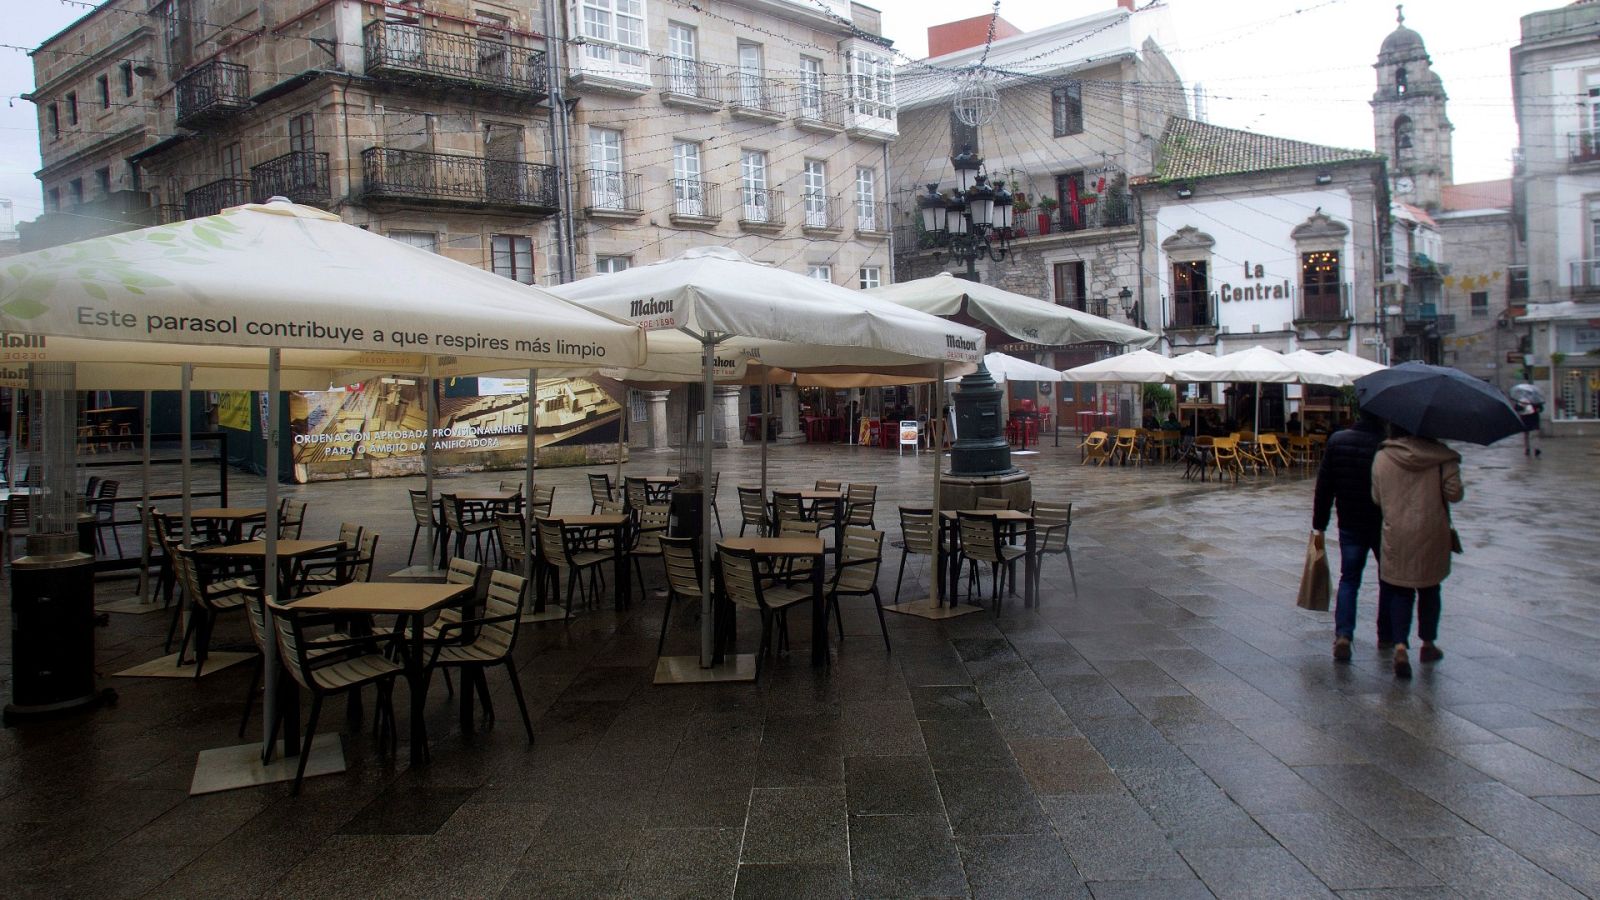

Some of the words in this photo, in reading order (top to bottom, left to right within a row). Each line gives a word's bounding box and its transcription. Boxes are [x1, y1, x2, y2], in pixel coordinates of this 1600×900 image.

[1244, 260, 1264, 279] La
[1221, 280, 1289, 303] Central
[630, 297, 674, 317] Mahou
[78, 306, 137, 328] Este
[147, 315, 237, 333] parasol
[246, 320, 364, 343] contribuye
[373, 329, 384, 342] a
[391, 330, 429, 347] que
[436, 332, 509, 351] respires
[515, 337, 550, 353] más
[557, 339, 606, 360] limpio
[946, 334, 977, 351] Mahou
[374, 429, 428, 440] APROBADA
[432, 424, 522, 438] PROVISIONALMENTE
[325, 446, 354, 456] PARA
[357, 445, 366, 454] O
[370, 440, 408, 453] ÁMBITO
[411, 442, 426, 451] DA
[432, 438, 499, 450] ANIFICADORA
